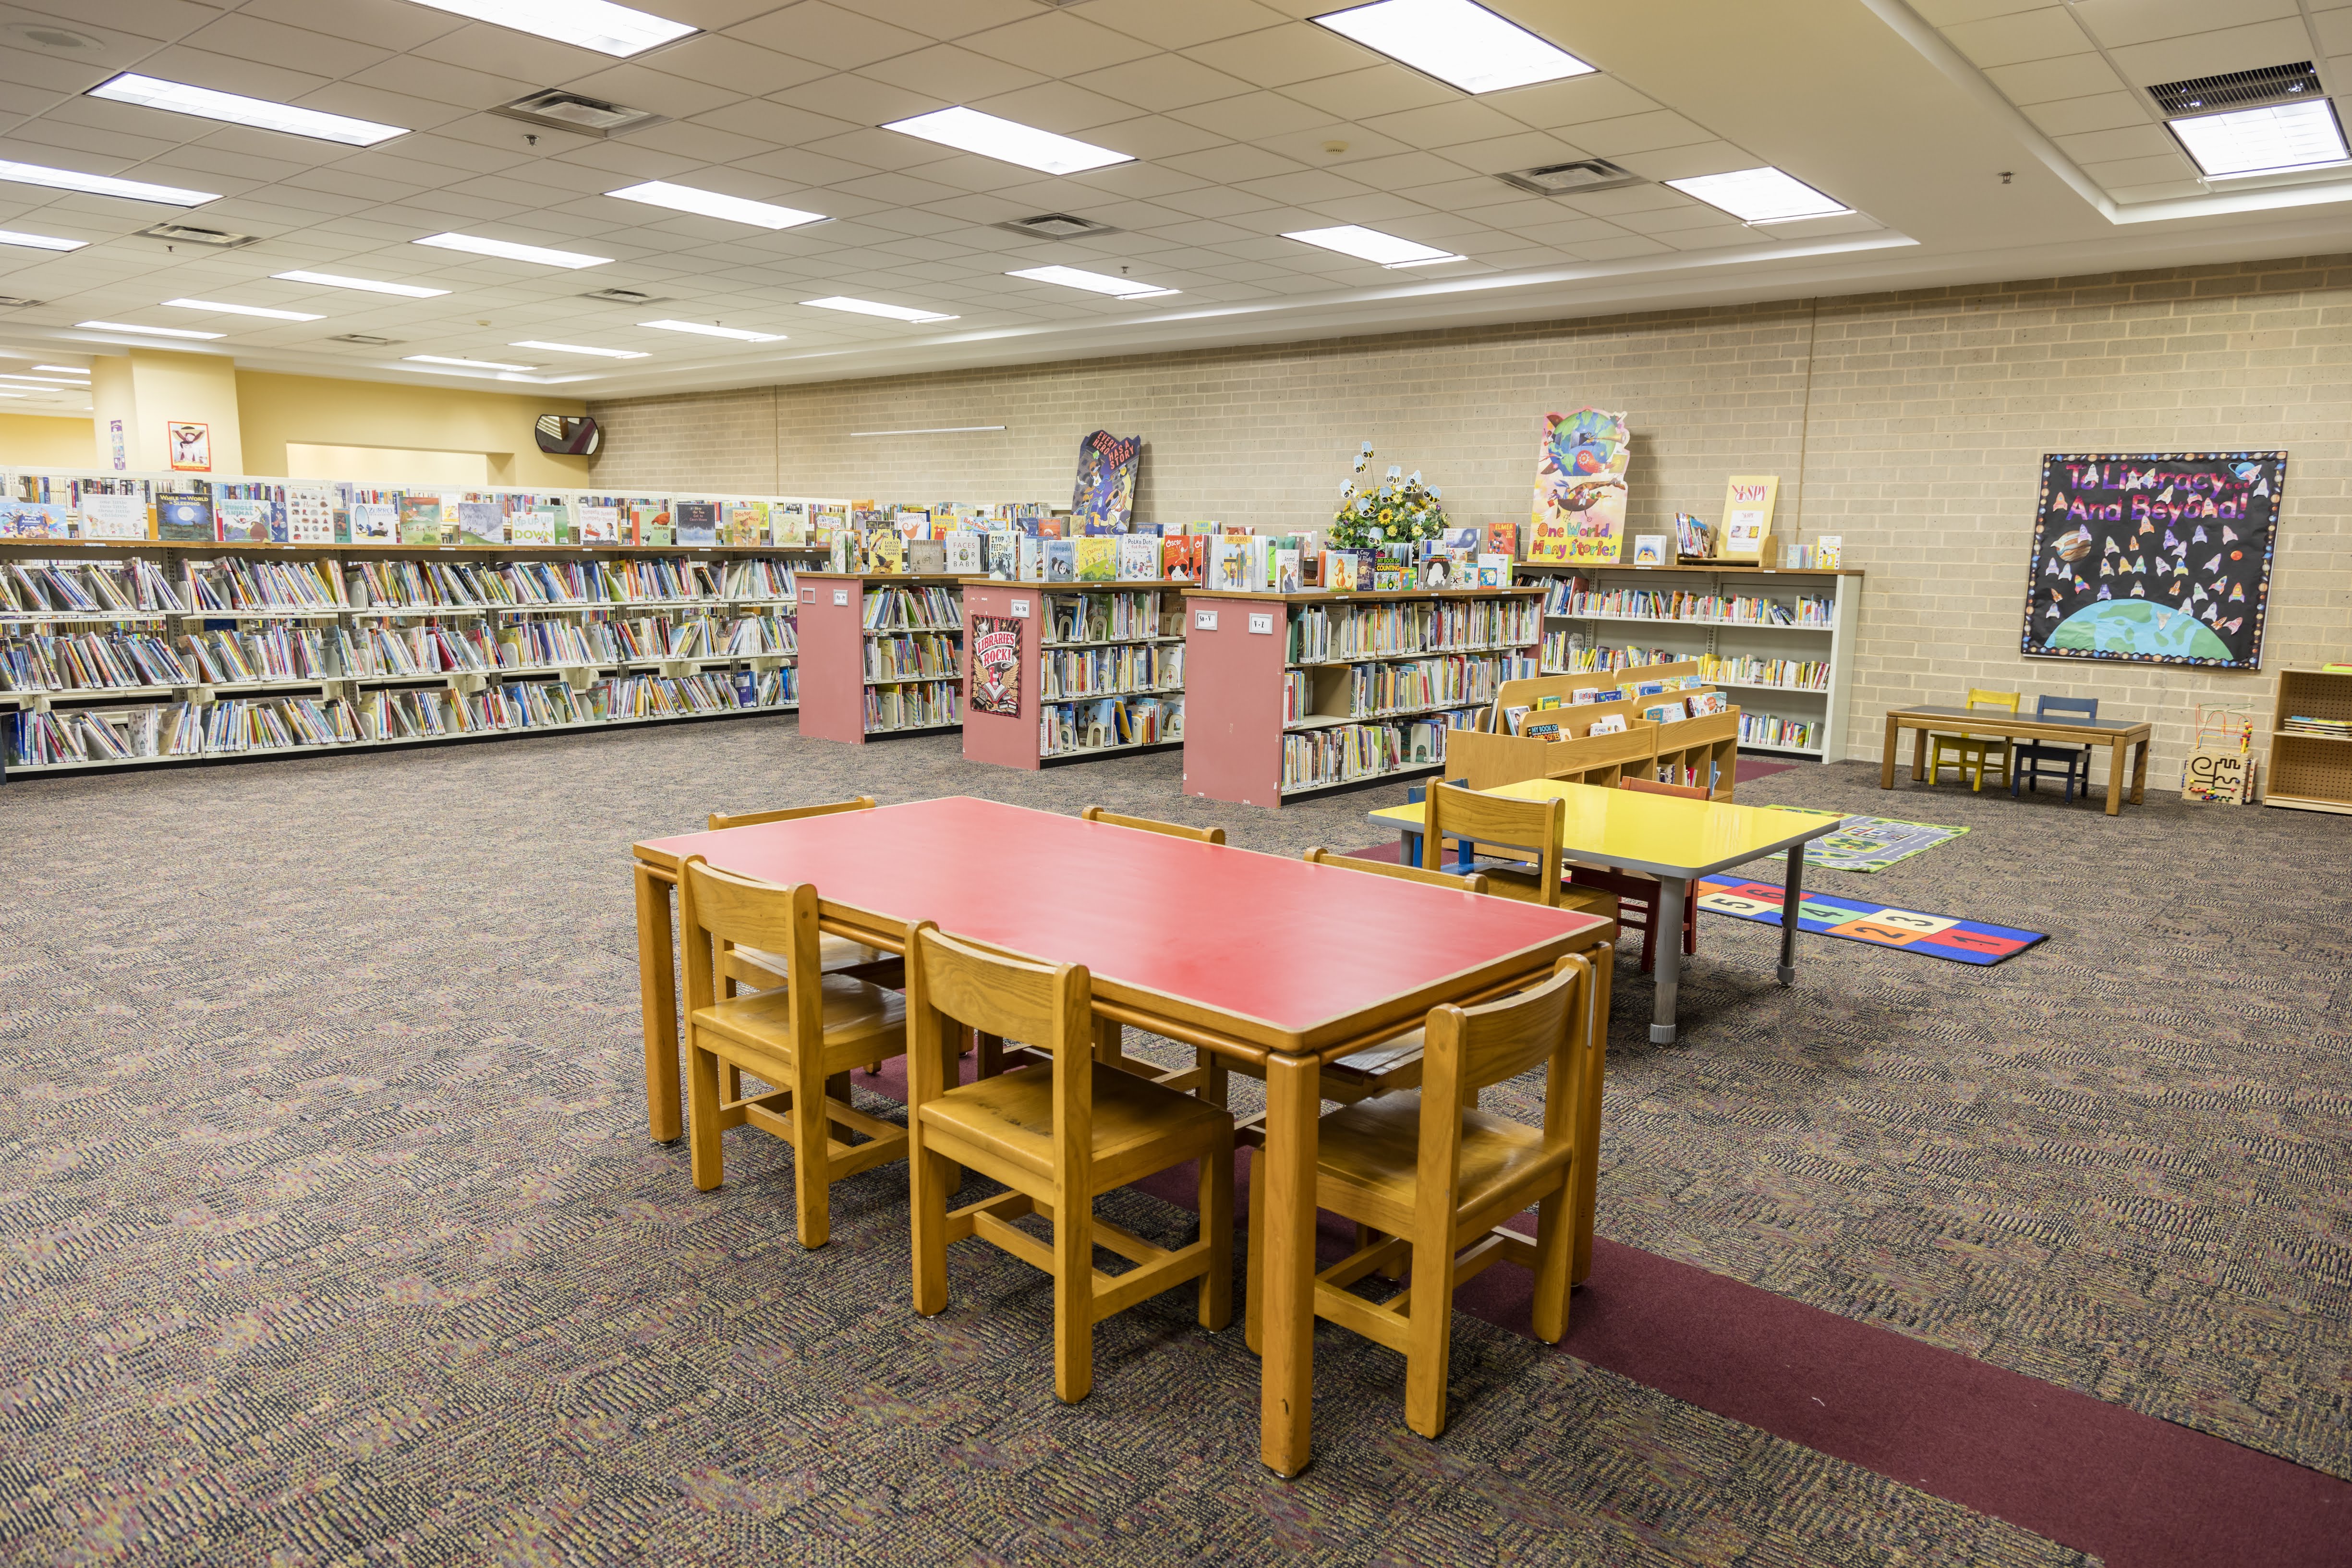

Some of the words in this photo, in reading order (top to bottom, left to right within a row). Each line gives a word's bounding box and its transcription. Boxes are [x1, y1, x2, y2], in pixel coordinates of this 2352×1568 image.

[1092, 438, 1110, 455] HERO
[1097, 431, 1117, 450] EVERY
[1108, 445, 1123, 461] HAS
[1125, 439, 1130, 449] A
[1110, 445, 1134, 470] STORY
[1747, 485, 1768, 501] SPY
[2066, 495, 2122, 521] And
[528, 517, 540, 525] UP
[540, 516, 553, 524] UP
[963, 517, 974, 526] BAD
[416, 525, 425, 534] Big
[974, 523, 989, 532] FROGS
[1537, 522, 1564, 537] One
[1567, 522, 1612, 540] World,
[514, 530, 553, 539] DOWN
[1082, 540, 1109, 551] Everybunny
[1165, 539, 1182, 547] Oscar
[1532, 540, 1566, 559] Many
[1569, 538, 1616, 557] Stories
[1087, 546, 1102, 556] Dance!
[977, 632, 1015, 653] LIBRARIES
[983, 648, 1011, 667] ROCK!
[1533, 734, 1560, 742] OPPOSITES
[1746, 888, 1784, 899] 6
[1710, 898, 1755, 910] 5
[1801, 907, 1844, 918] 4
[1889, 915, 1934, 927] 3
[1855, 926, 1907, 939] 2
[1952, 935, 2003, 947] 1
